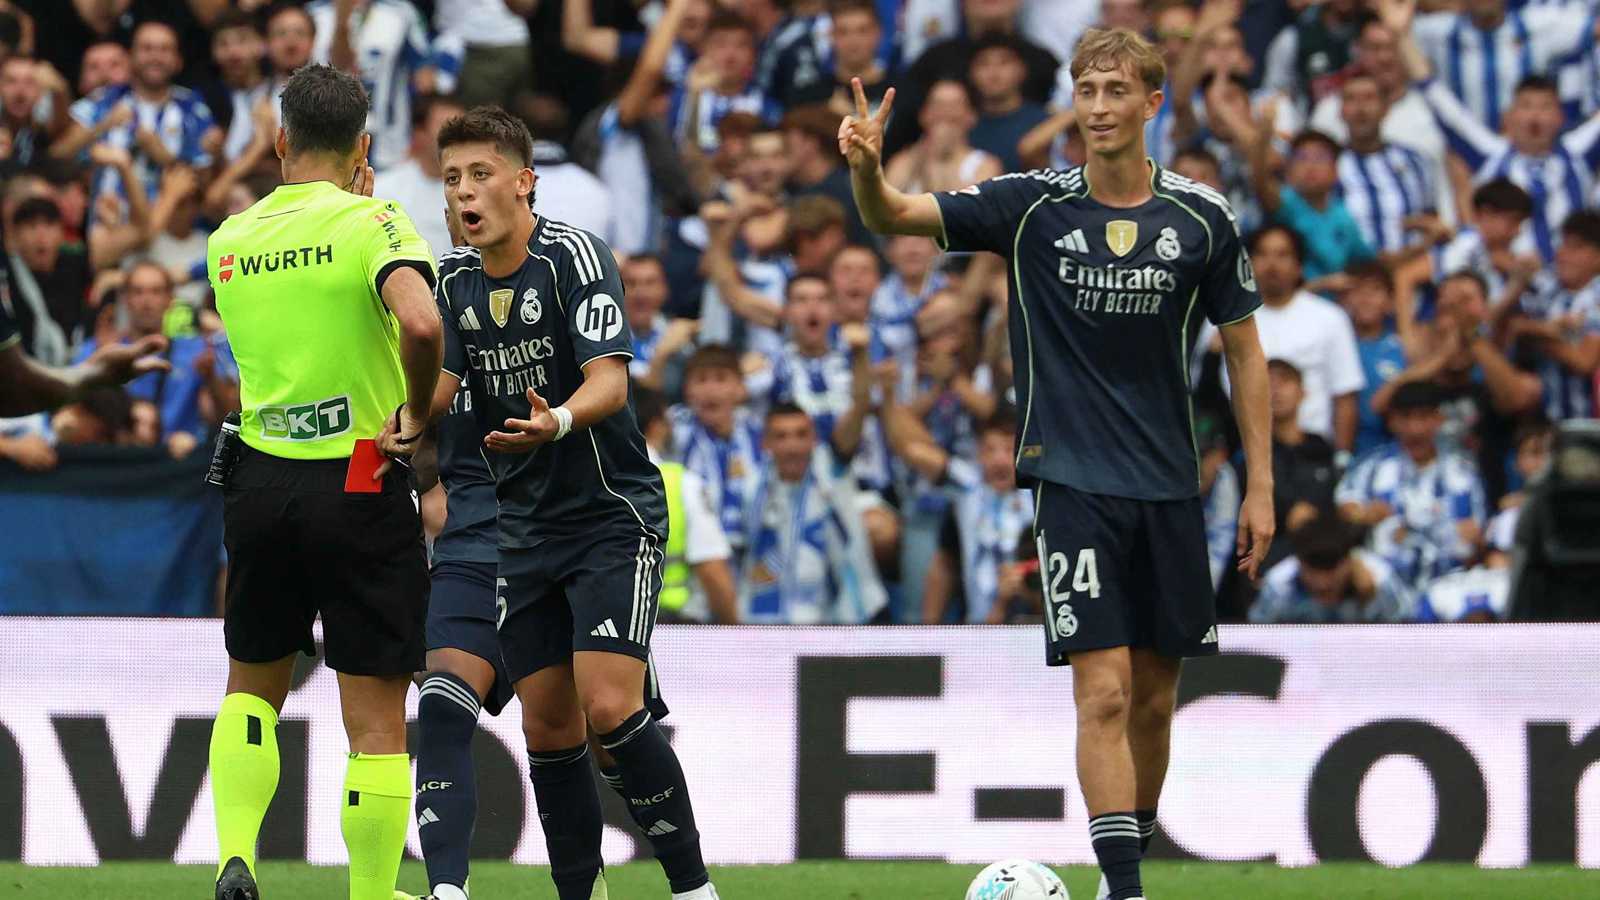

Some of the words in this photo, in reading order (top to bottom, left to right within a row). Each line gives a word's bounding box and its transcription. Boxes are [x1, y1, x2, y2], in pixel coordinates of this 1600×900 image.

[1059, 256, 1176, 292] Emirates
[583, 294, 617, 341] hp
[1075, 289, 1102, 312] FLY
[1104, 292, 1162, 315] BETTER
[260, 400, 348, 436] BKT
[1049, 548, 1101, 603] 24
[416, 780, 453, 796] MCF
